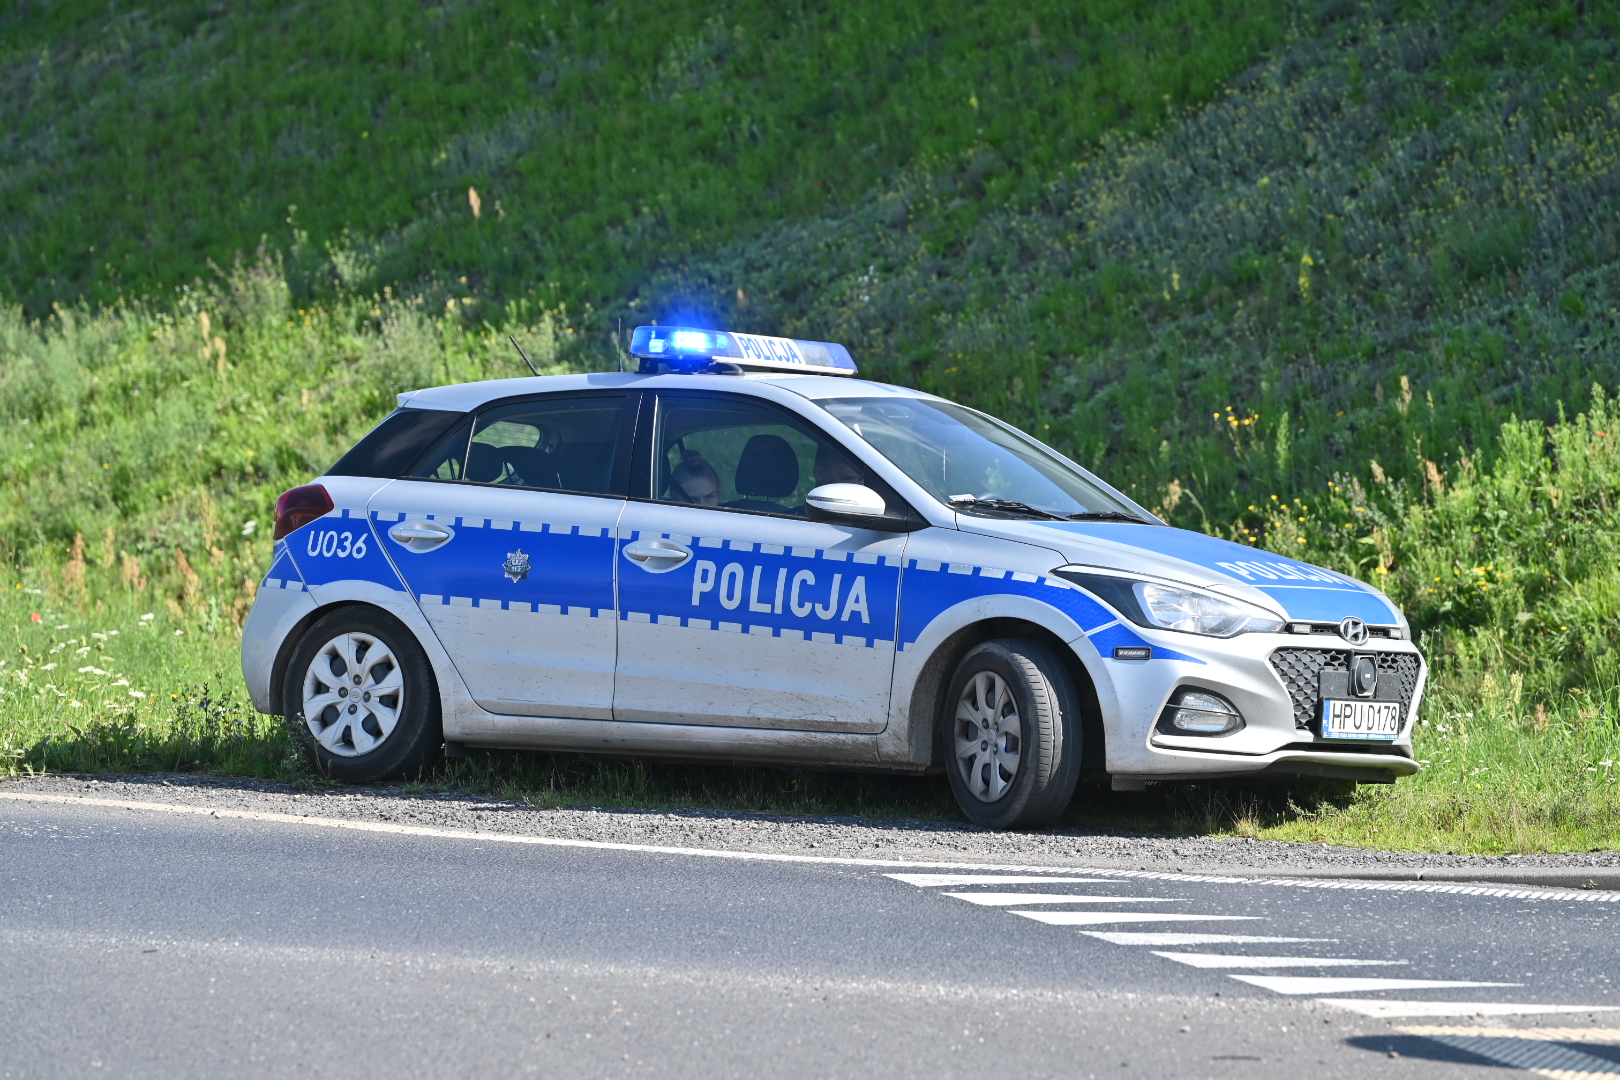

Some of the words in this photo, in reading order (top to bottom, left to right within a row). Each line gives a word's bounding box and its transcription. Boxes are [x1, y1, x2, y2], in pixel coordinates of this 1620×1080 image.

[737, 336, 802, 364] POLICJA
[307, 530, 369, 559] U036
[1214, 561, 1356, 588] POLICJA
[691, 559, 871, 624] POLICJA
[1331, 702, 1364, 730] HPU
[1366, 704, 1398, 731] D178
